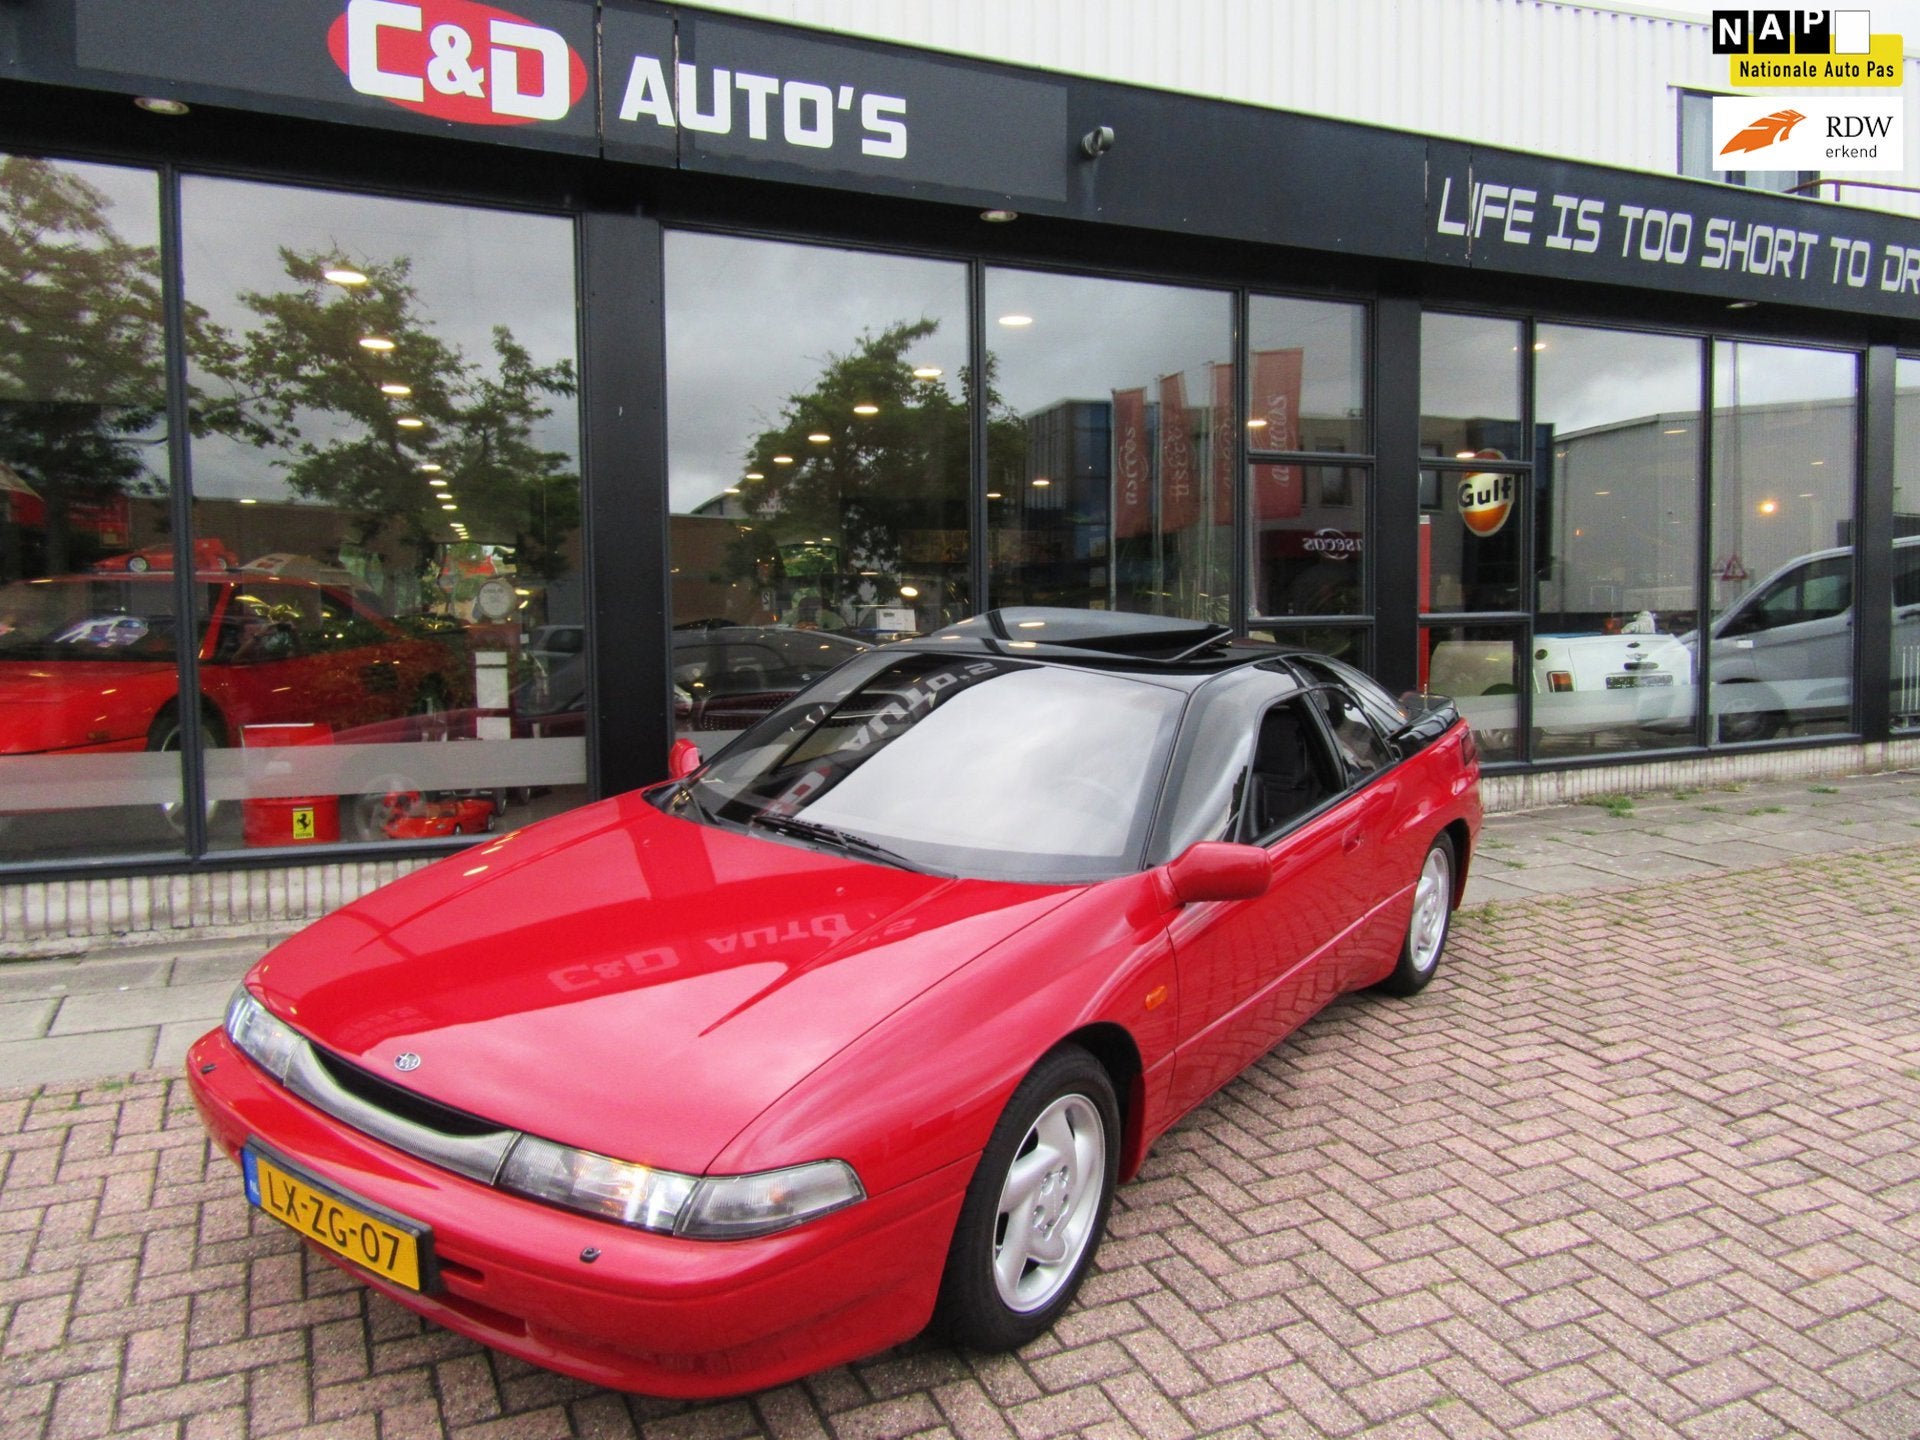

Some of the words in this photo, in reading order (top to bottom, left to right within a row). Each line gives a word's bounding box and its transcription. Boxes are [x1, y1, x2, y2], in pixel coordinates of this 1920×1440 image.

[347, 0, 570, 121] C&D
[619, 55, 907, 160] AUTO'S
[1437, 177, 1538, 245] LIFE
[1545, 194, 1605, 254] IS
[1618, 204, 1692, 265] TOO
[1701, 217, 1819, 280] SHORT
[1830, 236, 1871, 288] TO
[1458, 476, 1513, 508] Gulf
[267, 1171, 400, 1271] LX-ZG-07
